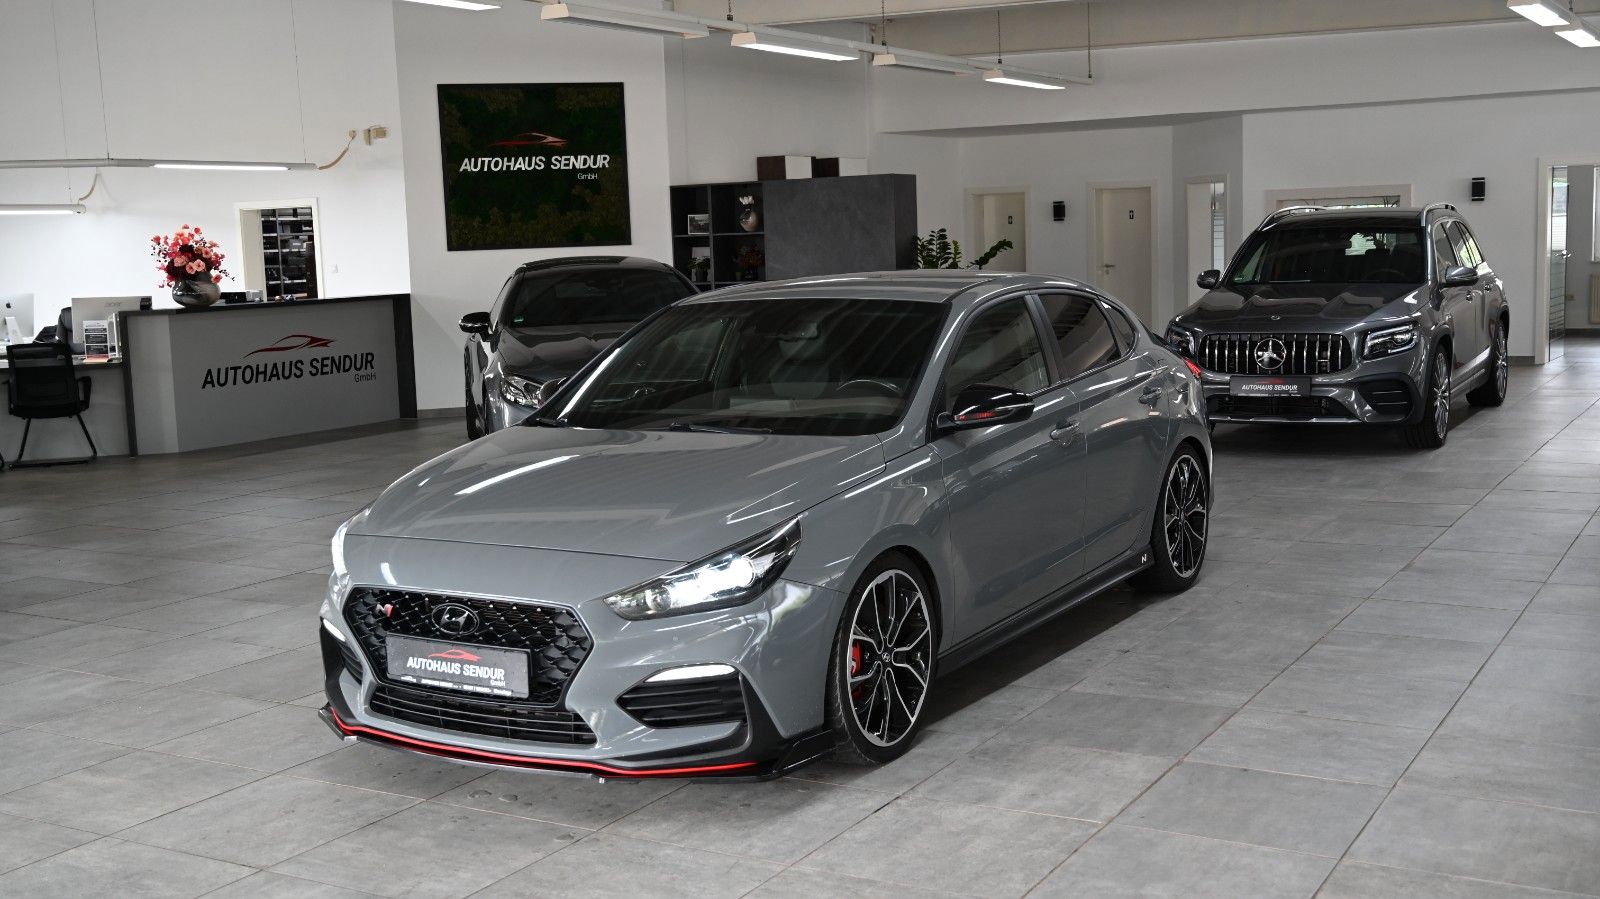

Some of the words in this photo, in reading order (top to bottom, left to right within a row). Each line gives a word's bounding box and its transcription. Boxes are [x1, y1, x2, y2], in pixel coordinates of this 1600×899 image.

[459, 156, 546, 172] AUTOHAUS
[551, 154, 610, 170] SENDUR
[201, 360, 305, 390] AUTOHAUS
[308, 352, 375, 377] SENDUR
[354, 373, 377, 383] GmbH
[406, 656, 461, 674] AUTOHAUS
[463, 664, 505, 681] SENDUR
[490, 679, 506, 687] GmbH
